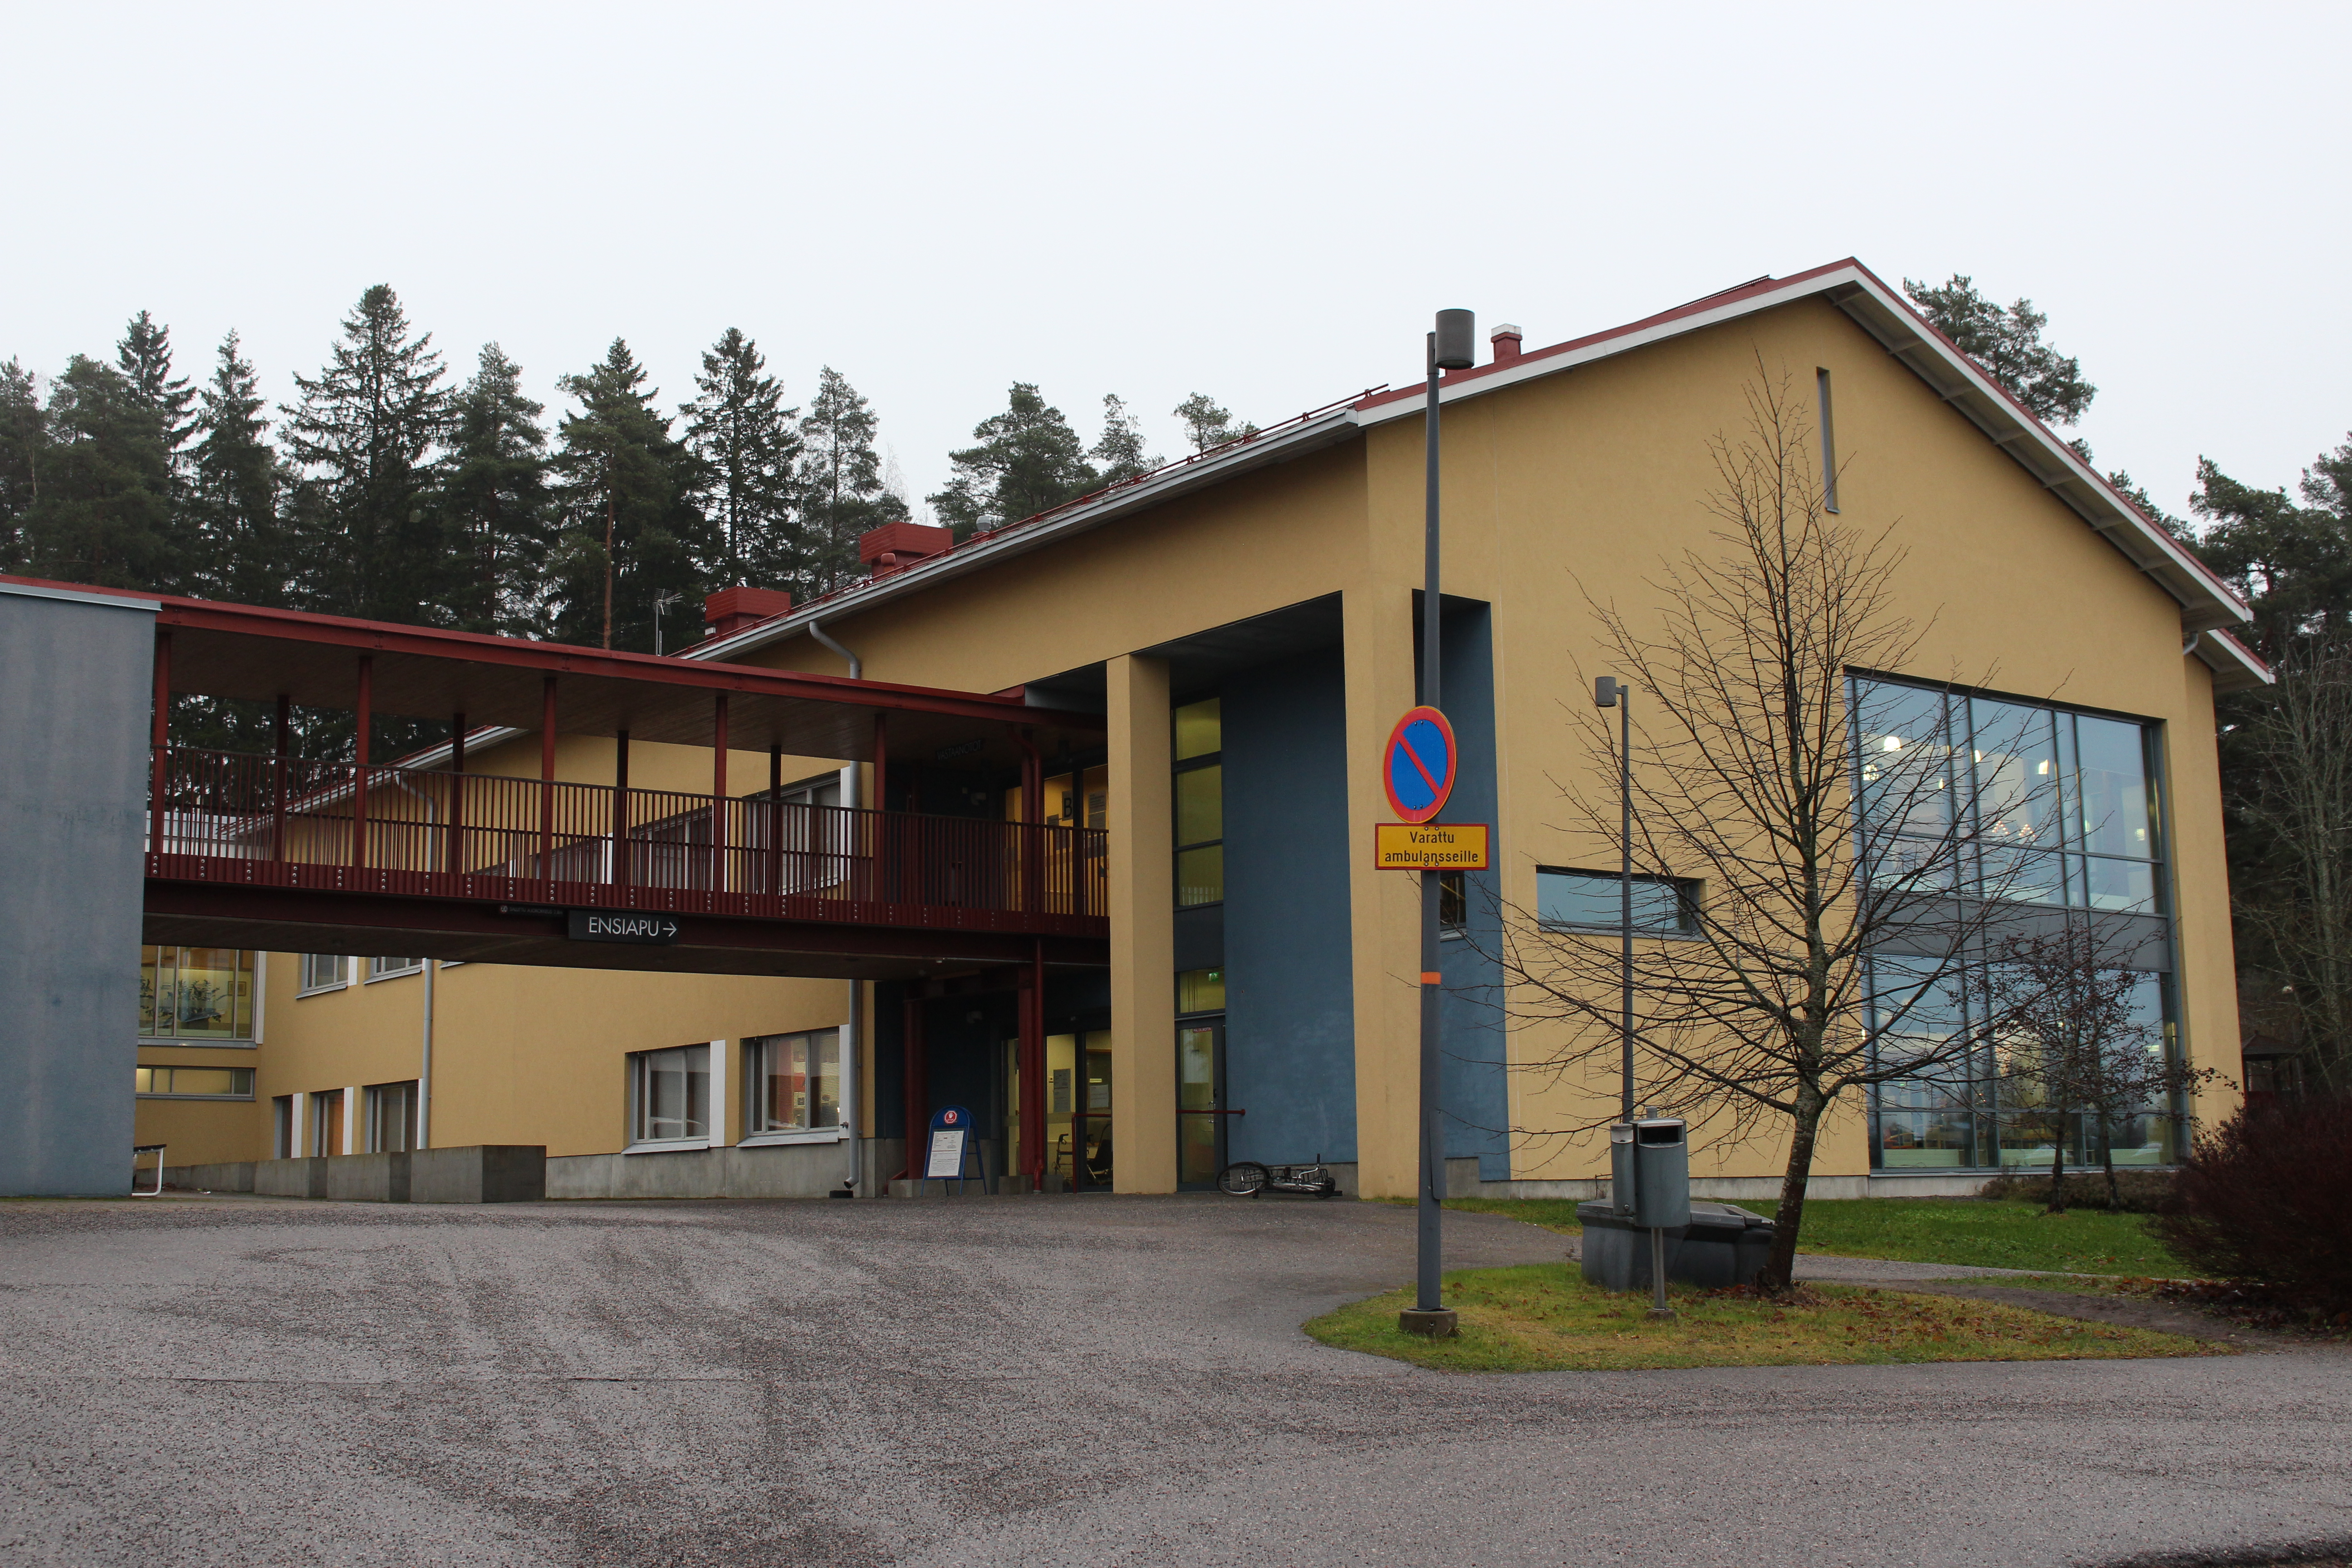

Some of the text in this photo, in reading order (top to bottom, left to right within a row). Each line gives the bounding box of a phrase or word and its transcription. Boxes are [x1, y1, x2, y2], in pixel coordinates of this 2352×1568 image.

[937, 740, 981, 760] VASTAANOTOT
[1064, 797, 1072, 818] B
[1410, 831, 1454, 843] Varattu
[1385, 850, 1478, 862] ambulansseille
[589, 916, 659, 936] ENSIAPU
